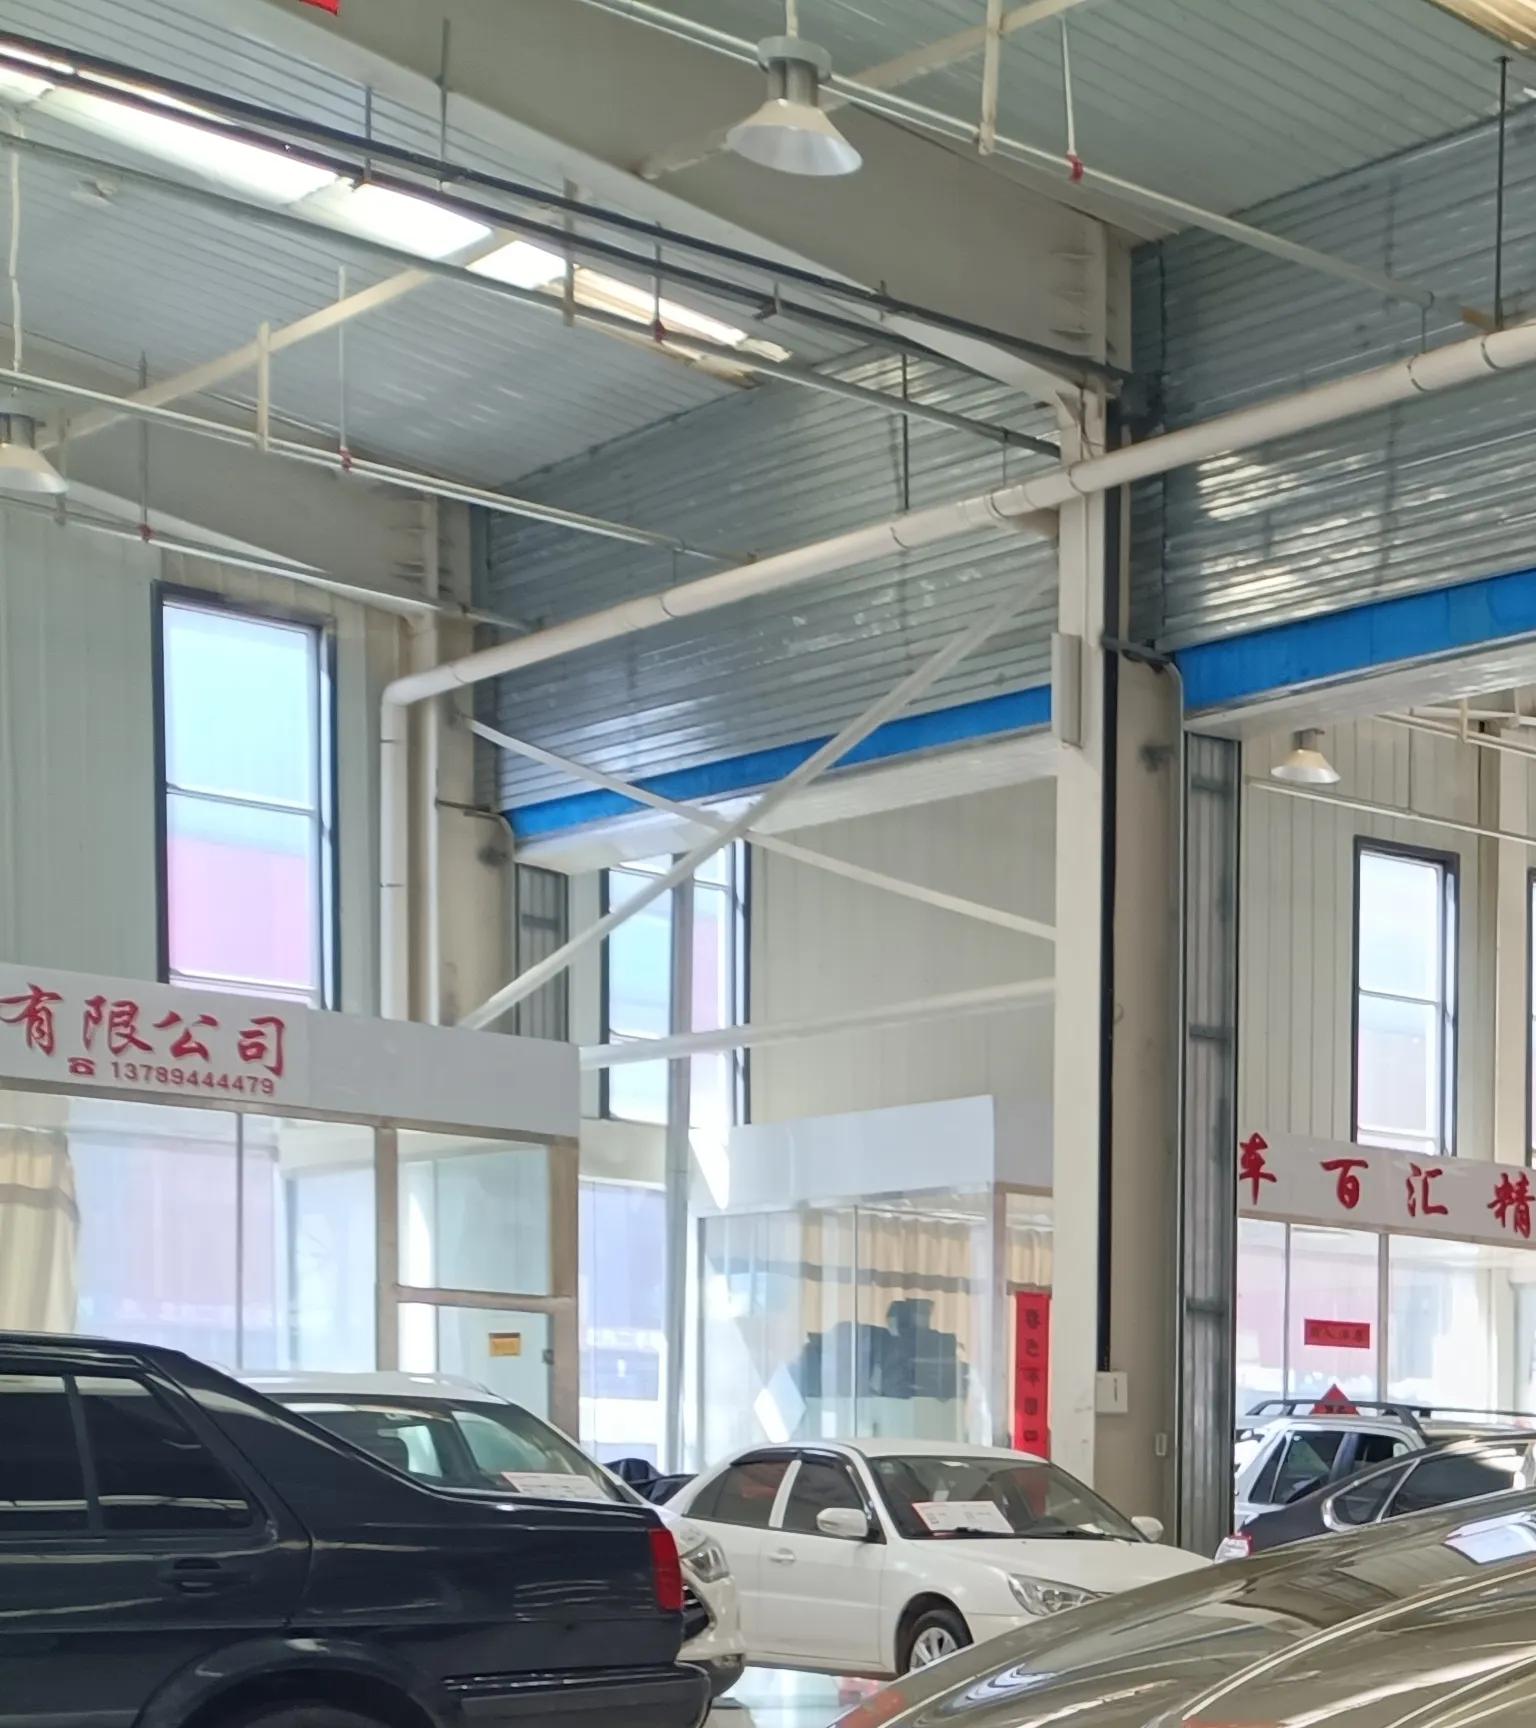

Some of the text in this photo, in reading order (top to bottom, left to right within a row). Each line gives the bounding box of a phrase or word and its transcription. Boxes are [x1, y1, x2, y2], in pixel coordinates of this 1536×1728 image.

[0, 983, 287, 1078] 有限公司
[110, 1059, 276, 1097] 13789444479
